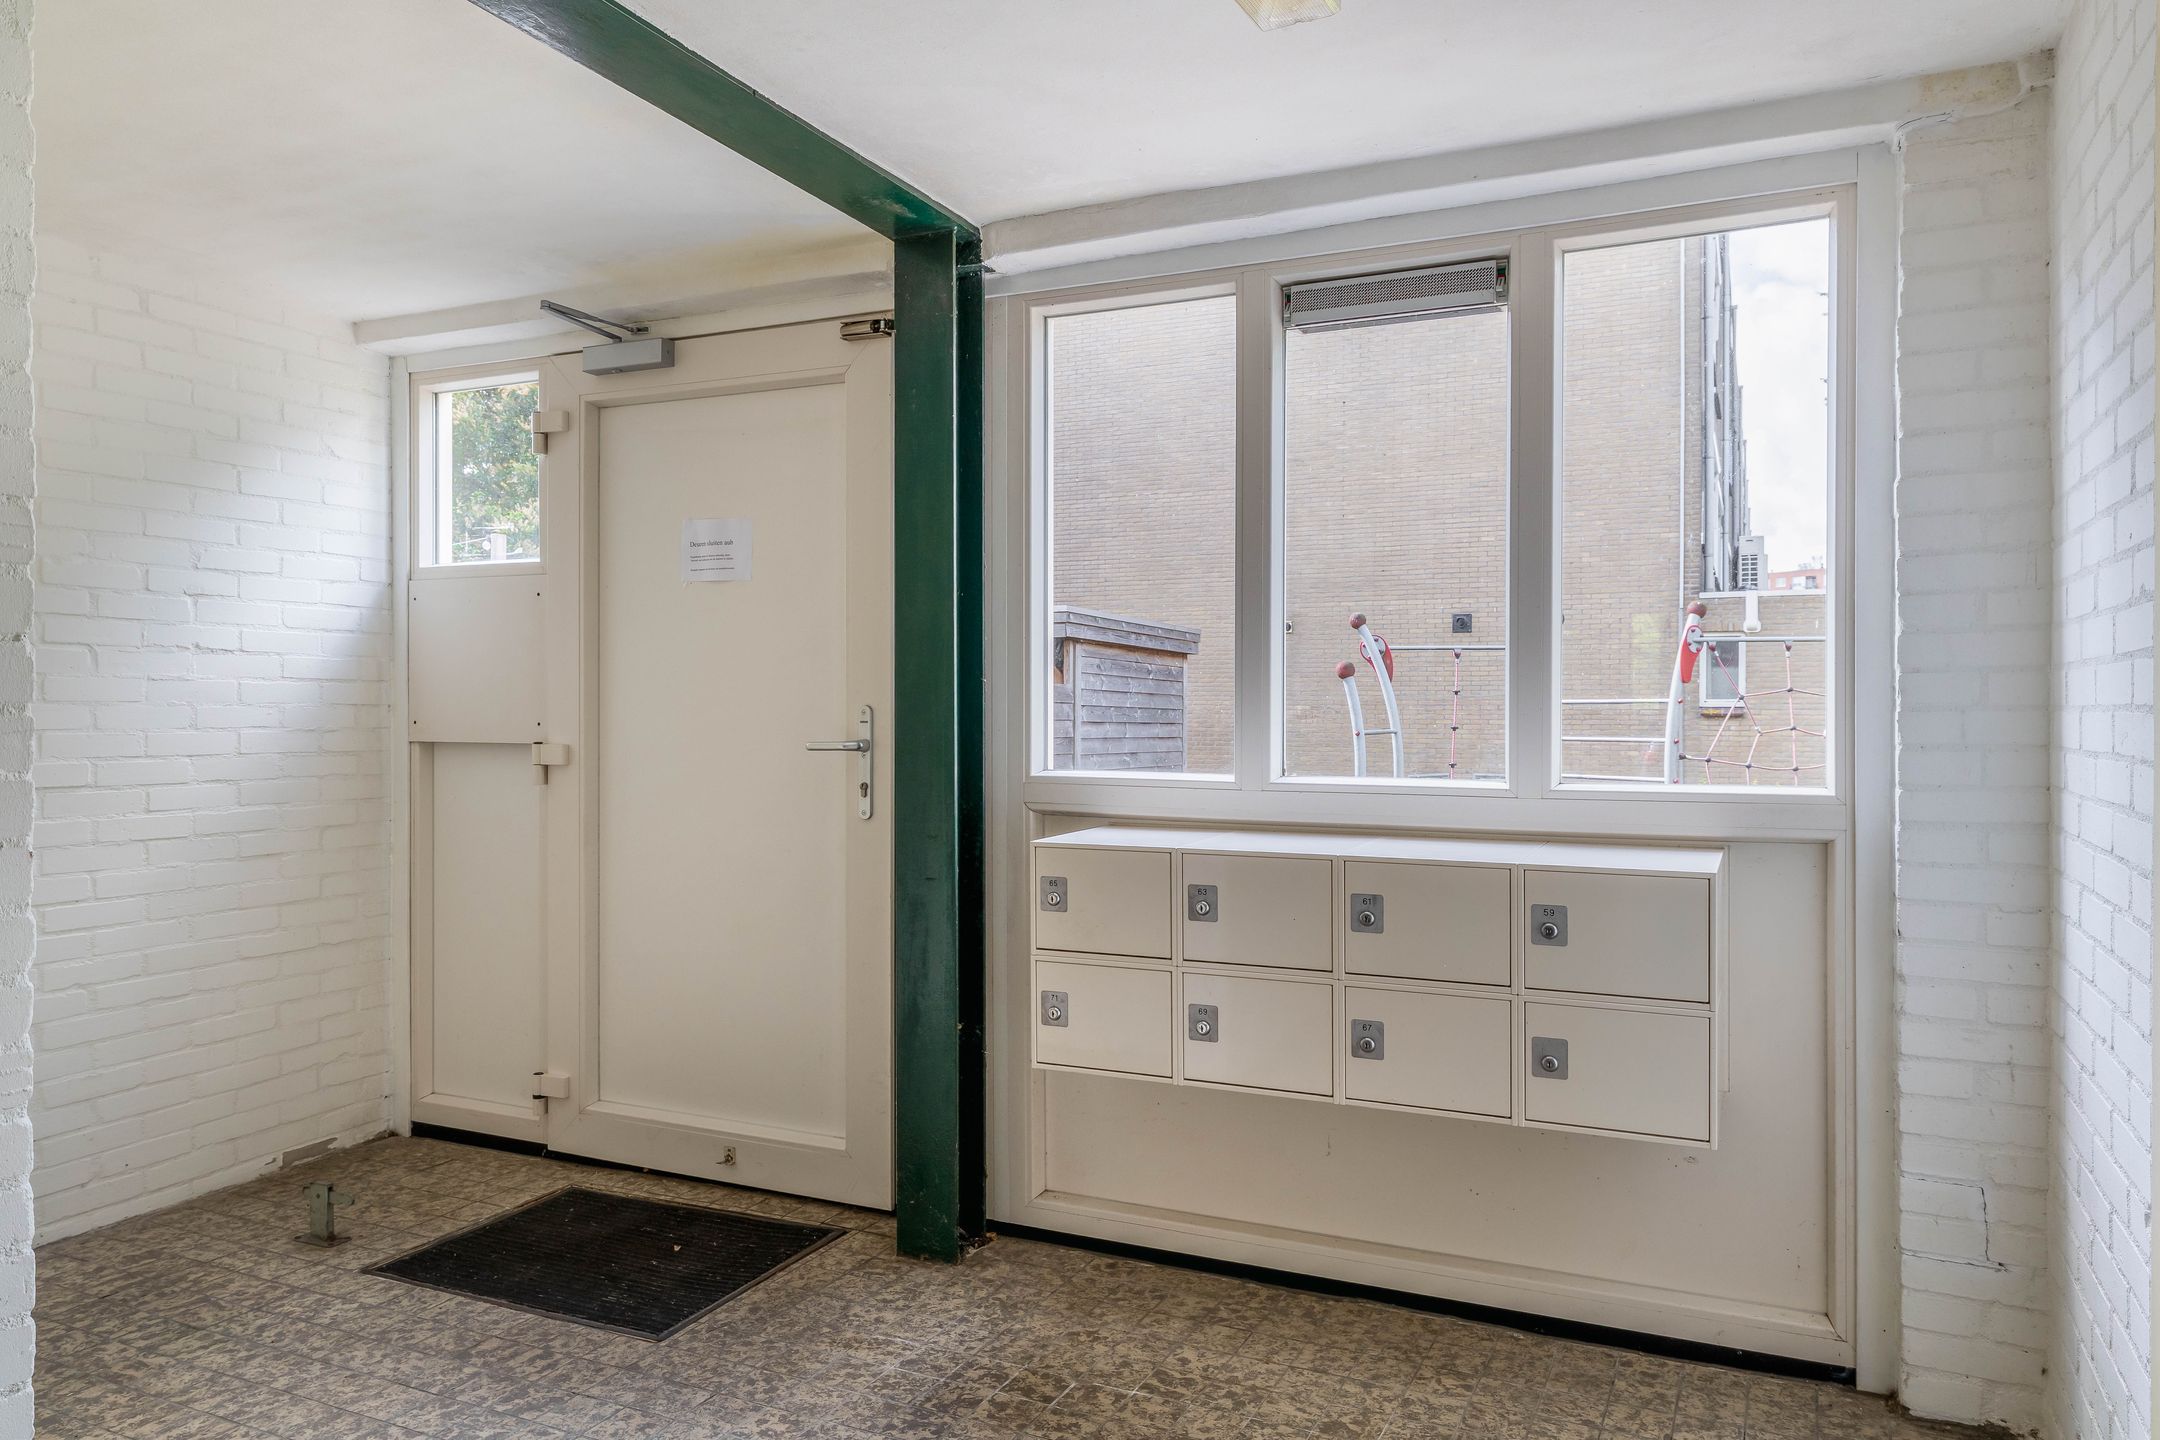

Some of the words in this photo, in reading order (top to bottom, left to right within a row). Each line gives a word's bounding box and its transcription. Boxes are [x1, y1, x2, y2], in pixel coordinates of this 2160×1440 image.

[1048, 879, 1058, 887] 65
[1197, 888, 1208, 896] 63
[1362, 897, 1372, 905] 61
[1543, 908, 1555, 917] 59
[1050, 994, 1059, 1002] 71
[1198, 1007, 1208, 1016] 69
[1362, 1024, 1372, 1032] 67
